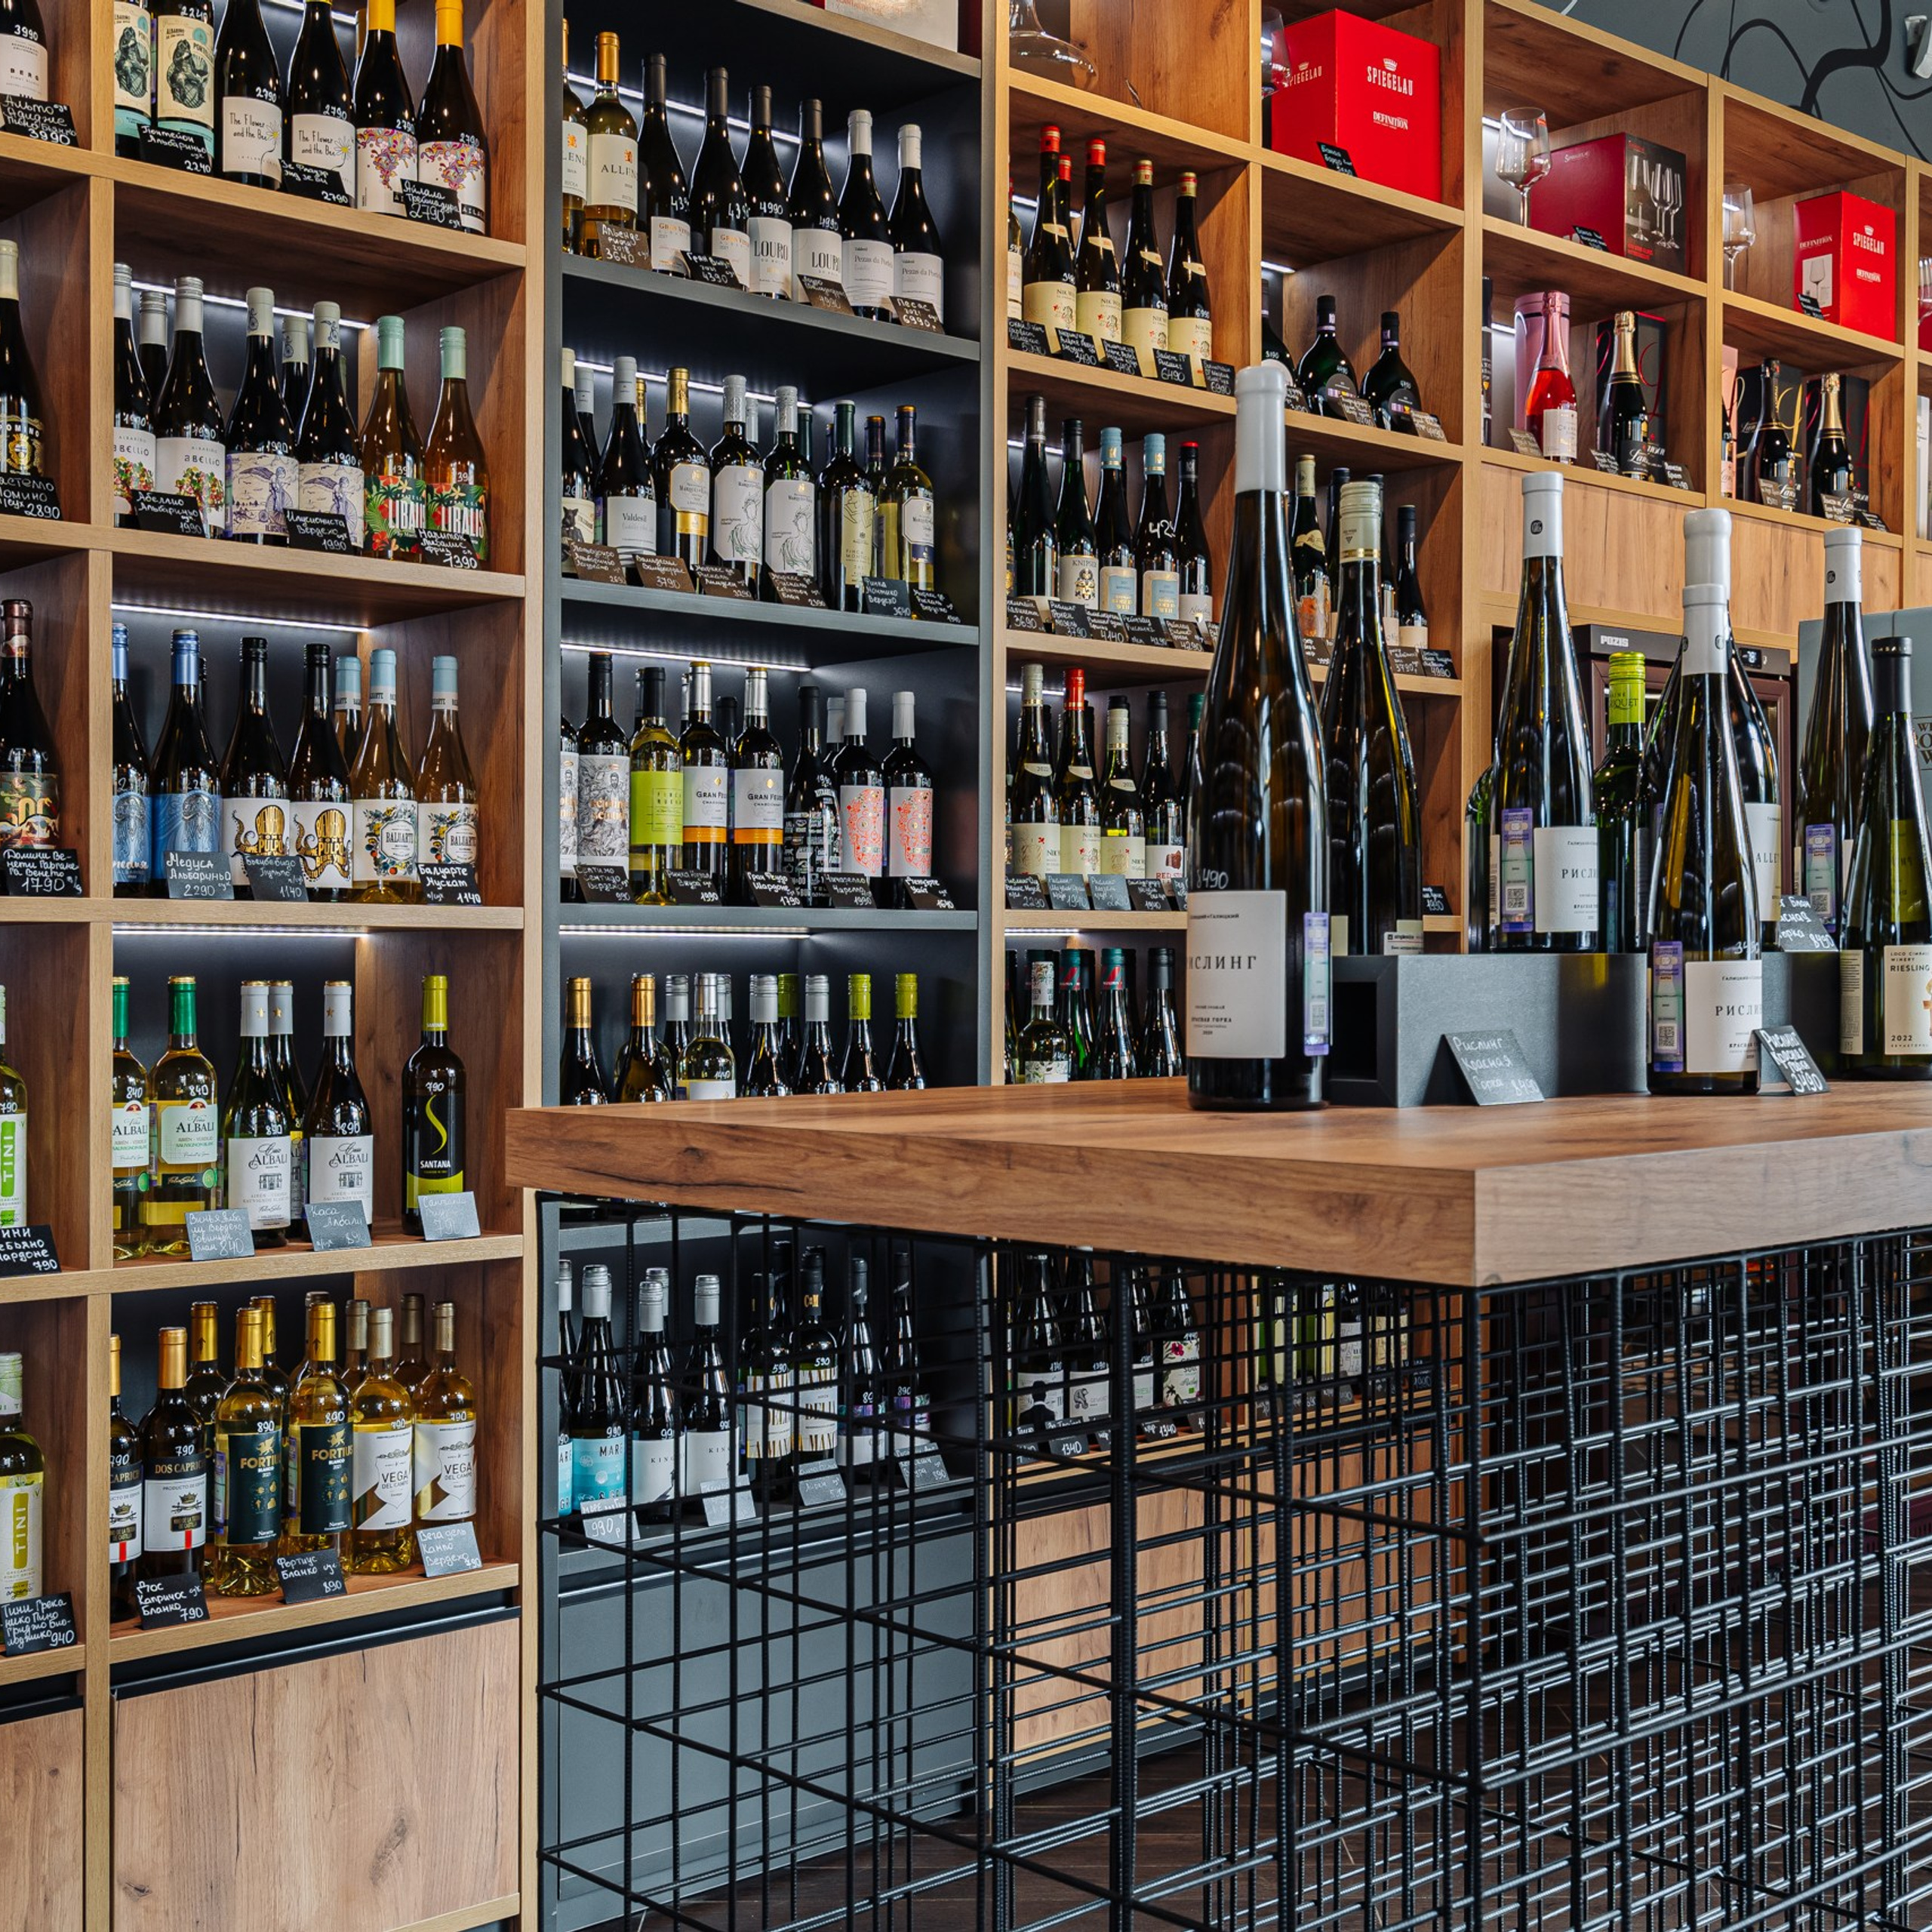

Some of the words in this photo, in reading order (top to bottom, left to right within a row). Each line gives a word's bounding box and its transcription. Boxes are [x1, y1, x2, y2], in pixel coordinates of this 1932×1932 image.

[14, 24, 38, 41] 3990
[1367, 65, 1414, 96] SPIEGELAU
[256, 87, 277, 103] 2790
[323, 104, 348, 121] 2790
[230, 112, 242, 125] The
[244, 114, 266, 128] Flower
[1373, 111, 1408, 131] DEFINITION
[28, 129, 71, 146] 3990
[233, 128, 245, 137] and
[245, 128, 257, 138] the
[257, 129, 268, 140] Bee
[298, 130, 309, 141] The
[312, 131, 334, 143] Flower
[301, 145, 313, 155] and
[313, 144, 324, 155] the
[325, 146, 337, 156] Bee
[184, 160, 211, 174] 2240
[321, 191, 349, 204] 2790
[409, 204, 445, 223] 2790
[759, 202, 783, 215] 4990
[819, 215, 838, 231] 4990
[1799, 235, 1833, 249] DEFINITION
[1853, 232, 1885, 255] SPIEGELAU
[605, 248, 635, 263] 3640
[754, 240, 788, 260] LOURO
[702, 272, 728, 284] 4390
[1856, 268, 1881, 283] DEFINITION
[903, 314, 931, 328] 6990
[1075, 352, 1097, 366] 3490
[1160, 368, 1185, 382] 6490
[1210, 382, 1232, 395] 6990
[123, 412, 146, 426] 1990
[191, 426, 217, 439] 1990
[25, 501, 60, 519] 2890
[180, 522, 203, 535] 1990
[441, 506, 485, 538] LIBALIS
[321, 538, 347, 551] 1990
[442, 554, 478, 569] 1390
[657, 576, 680, 589] 3790
[733, 589, 752, 598] 3290
[893, 606, 912, 617] 3640
[1013, 614, 1037, 629] 3690
[1066, 627, 1088, 638] 3790
[1100, 629, 1124, 643] 4140
[1180, 640, 1202, 652] 4290
[1601, 635, 1629, 648] POZIS
[1196, 868, 1229, 889] 8490
[22, 878, 65, 894] 1790
[183, 883, 216, 897] 2290
[279, 884, 302, 898] 1140
[457, 892, 481, 904] 1140
[616, 892, 630, 902] 990
[700, 892, 718, 903] 1990
[780, 896, 800, 906] 1790
[854, 896, 872, 906] 1990
[1023, 897, 1045, 908] 2290
[1066, 897, 1088, 908] 1940
[1810, 934, 1835, 949] 8490
[1453, 1036, 1503, 1051] Рислинг
[1760, 1029, 1799, 1048] Рислинг
[1461, 1055, 1512, 1071] Красная
[1770, 1048, 1806, 1066] Красная
[425, 1081, 444, 1093] 790
[1473, 1075, 1504, 1090] Горка
[1794, 1073, 1824, 1094] 3490
[126, 1086, 143, 1100] 840
[189, 1084, 209, 1097] 840
[176, 1121, 214, 1134] ALBALI
[266, 1124, 283, 1137] 890
[340, 1121, 361, 1136] 890
[3, 1135, 14, 1183] TINI
[248, 1153, 288, 1170] ALBALI
[328, 1152, 369, 1168] ALBALI
[420, 1160, 451, 1169] SANTANA
[220, 1240, 244, 1257] 840
[32, 1259, 57, 1271] 790
[772, 1363, 788, 1374] 590
[815, 1357, 830, 1367] 590
[325, 1411, 345, 1423] 890
[257, 1420, 275, 1433] 890
[606, 1426, 622, 1438] 990
[1158, 1426, 1177, 1438] 1340
[174, 1444, 195, 1457] 790
[312, 1444, 354, 1462] FORTIUS
[1062, 1441, 1082, 1456] 1340
[155, 1464, 172, 1475] DOS
[444, 1463, 472, 1475] VEGA
[382, 1472, 409, 1484] VEGA
[15, 1506, 26, 1555] TINI
[592, 1520, 614, 1537] 990
[323, 1581, 343, 1593] 890
[3, 1603, 33, 1617] Тини
[180, 1607, 205, 1622] 790
[51, 1630, 75, 1647] 940
